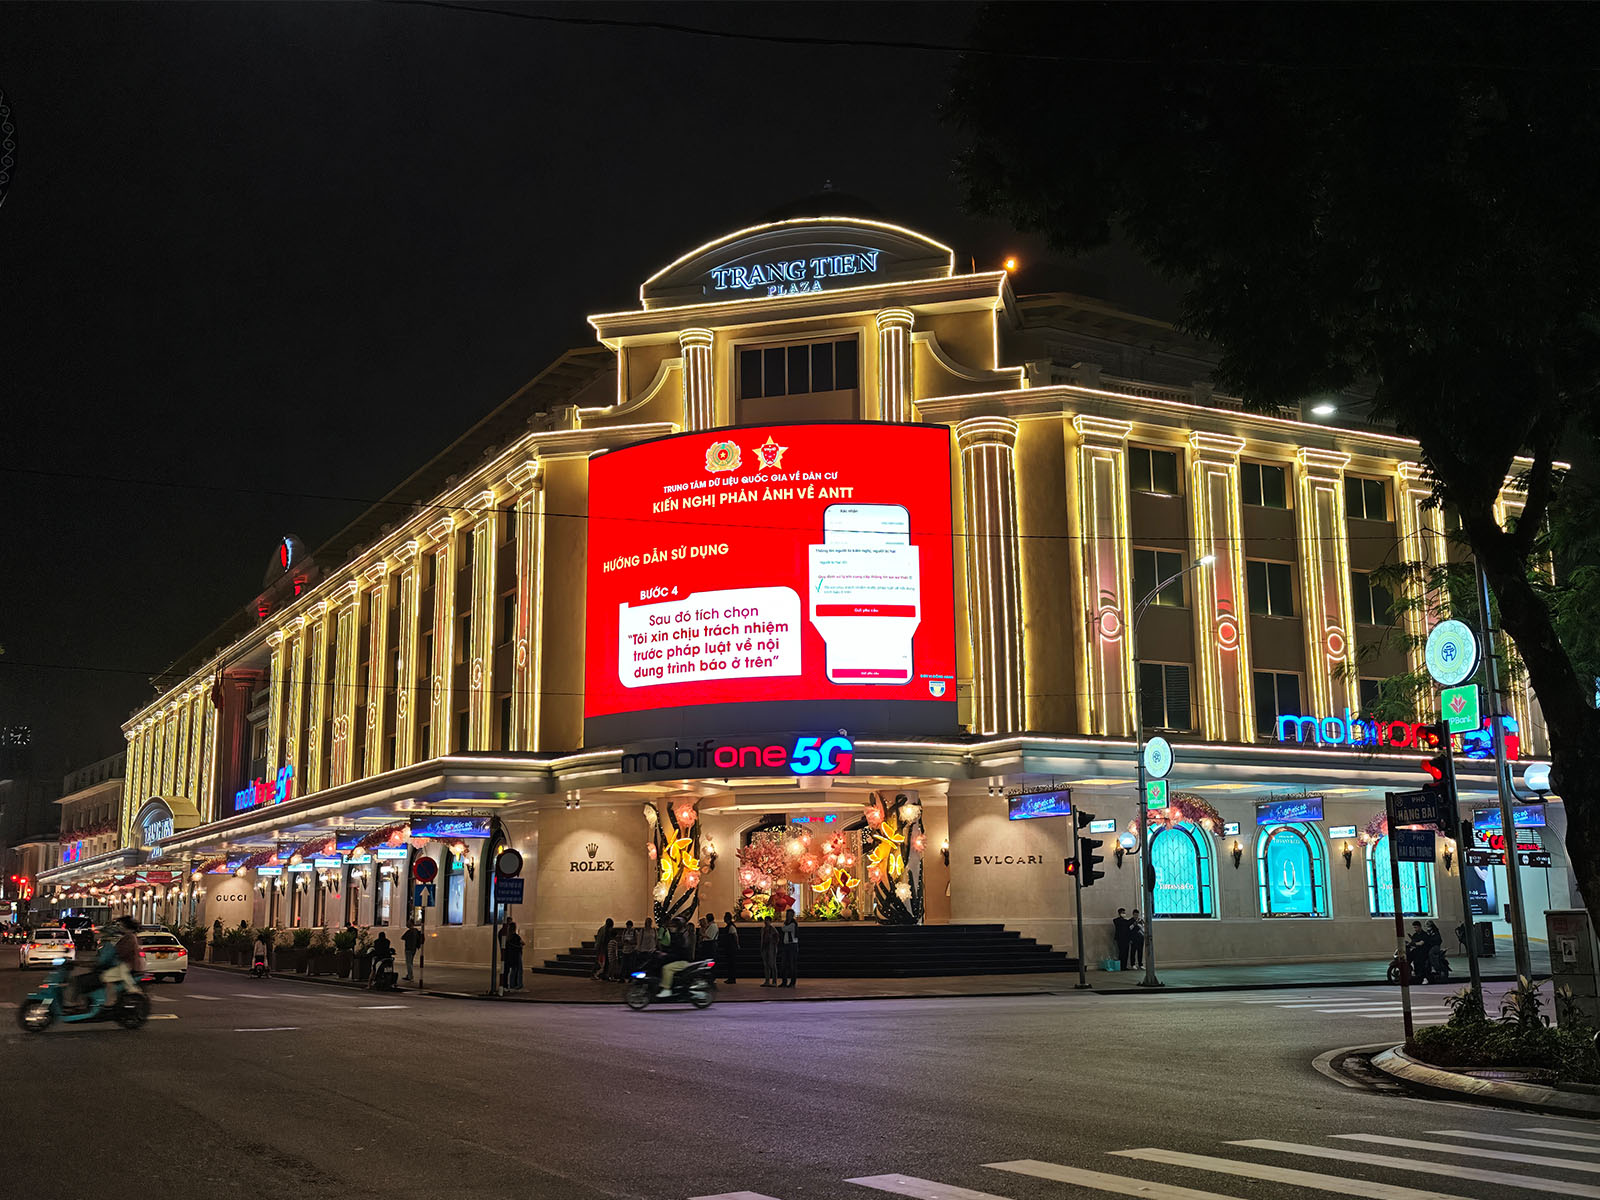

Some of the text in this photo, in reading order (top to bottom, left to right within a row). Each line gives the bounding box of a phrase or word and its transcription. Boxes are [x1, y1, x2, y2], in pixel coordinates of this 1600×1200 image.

[712, 251, 879, 290] TRANG TIEN
[767, 280, 823, 297] PLAZA
[663, 470, 839, 494] TRUNG TÂM DỮ LIỆU QUỐC GIA VỀ DÂN CƯ
[653, 484, 854, 514] KIẾN NGHỊ PHẢN ẢNH VỀ ANTT
[603, 543, 729, 573] HƯỚNG DẪN SỬ DỤNG
[640, 586, 678, 600] BƯỚC 4
[649, 606, 759, 626] Sau đó tích chọn
[651, 630, 668, 642] xin
[672, 628, 699, 641] chịu
[704, 624, 739, 636] trách
[744, 621, 789, 635] nhiệm
[633, 637, 779, 661] trước pháp luật về nội
[634, 666, 664, 679] dung
[667, 661, 695, 674] trình
[699, 659, 727, 671] báo
[731, 659, 741, 669] ở
[621, 736, 853, 775] mobifone 5G
[824, 814, 837, 823] 5G
[1398, 804, 1436, 820] HÀNG BÀI
[570, 861, 615, 872] ROLEX
[973, 855, 1043, 865] BVLGARI
[216, 894, 247, 902] GUCCI
